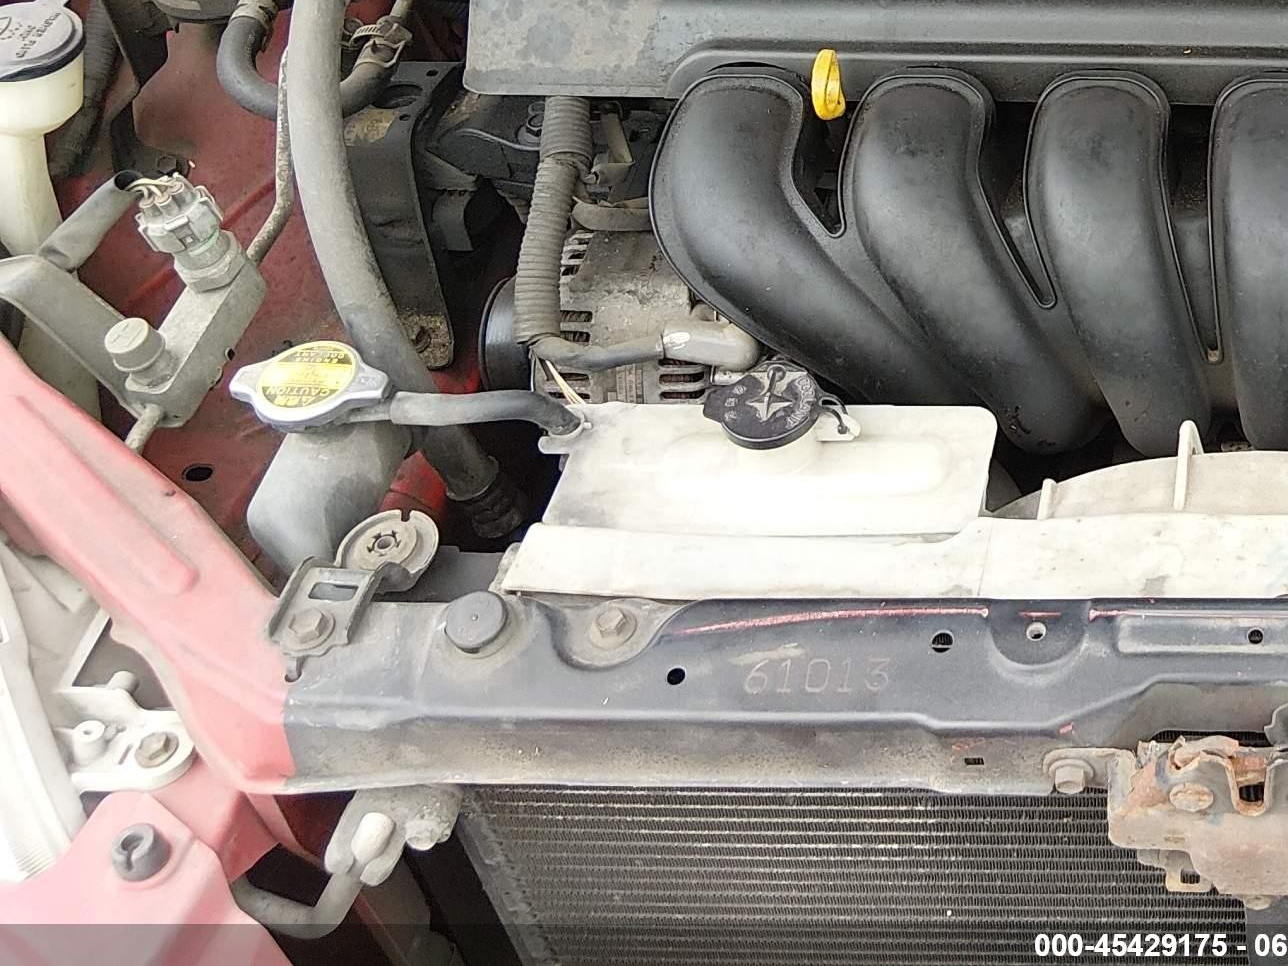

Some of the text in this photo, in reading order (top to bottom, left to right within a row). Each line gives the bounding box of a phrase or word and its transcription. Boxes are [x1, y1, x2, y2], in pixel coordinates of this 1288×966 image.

[266, 386, 330, 397] CAUTION
[785, 375, 816, 430] COOLANT
[744, 658, 892, 695] 61013
